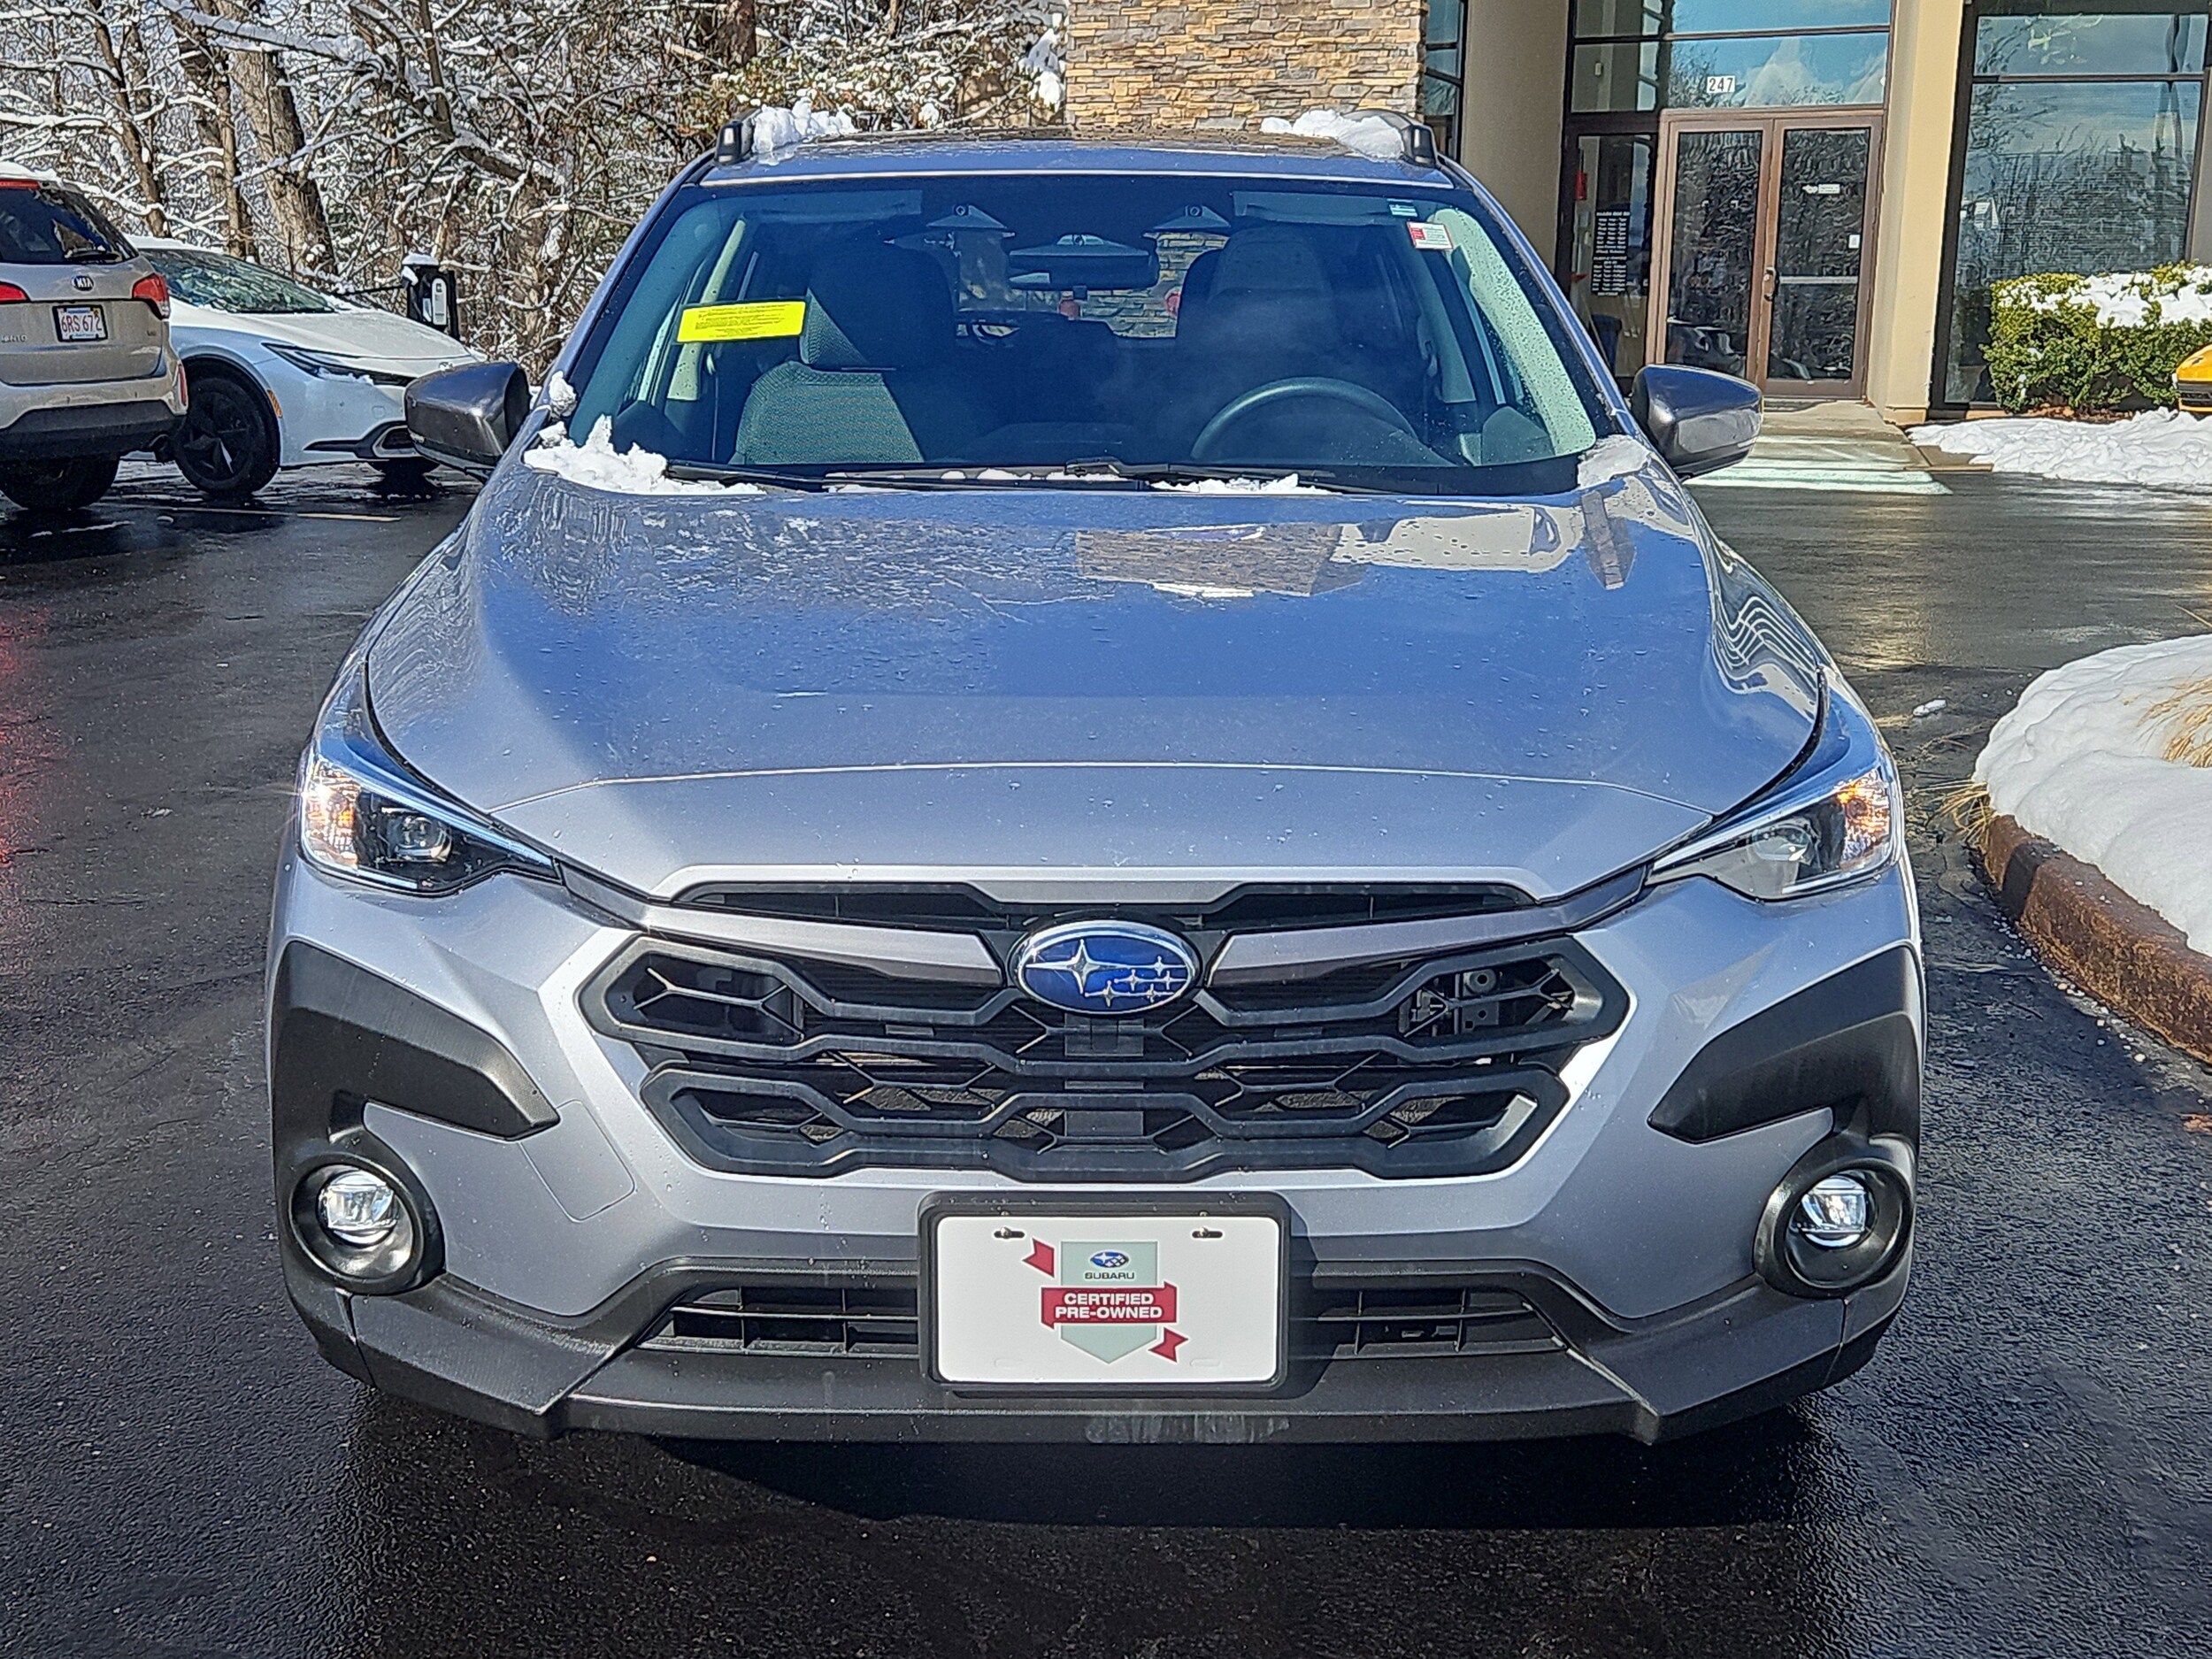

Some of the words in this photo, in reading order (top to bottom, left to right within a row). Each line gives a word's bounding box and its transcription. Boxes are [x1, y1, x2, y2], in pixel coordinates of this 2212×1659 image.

[1709, 77, 1733, 92] 247
[77, 277, 93, 288] KIA
[61, 314, 81, 333] 6RS
[82, 314, 103, 332] 672
[1084, 1271, 1135, 1280] SUBARU
[1064, 1292, 1155, 1306] CERTIFIED
[1055, 1306, 1163, 1319] PRE-OWNED
